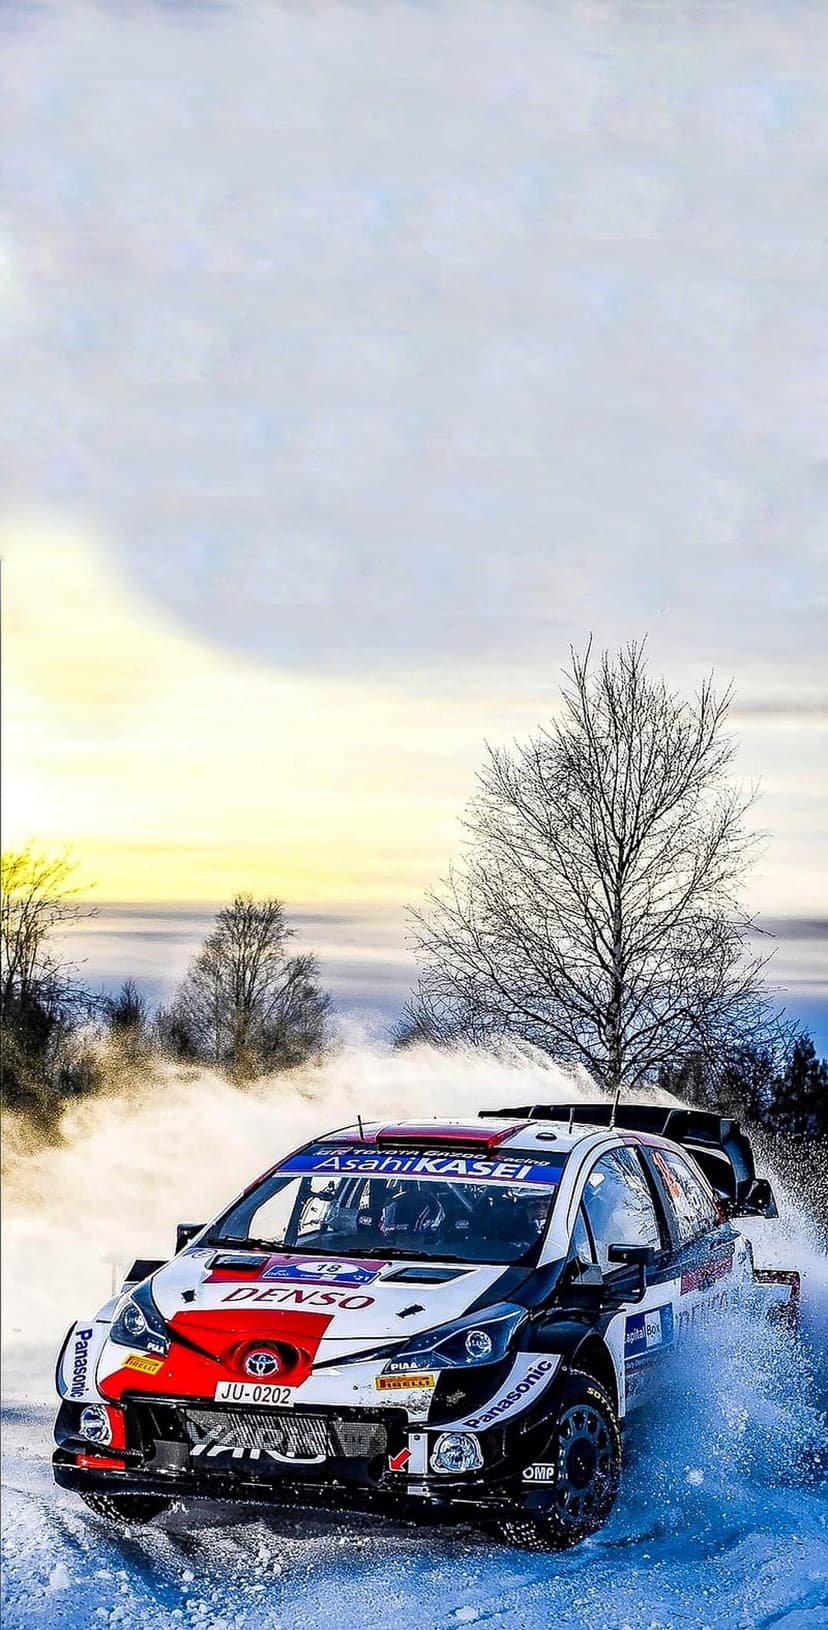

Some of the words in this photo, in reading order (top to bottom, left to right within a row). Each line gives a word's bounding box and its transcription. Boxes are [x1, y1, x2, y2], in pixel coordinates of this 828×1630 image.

[316, 1264, 342, 1272] 18
[222, 1287, 376, 1310] DENSO
[71, 1328, 93, 1398] Panasonic
[125, 1356, 160, 1372] PIRELLI
[390, 1362, 418, 1371] PIAA
[379, 1375, 431, 1389] PIRELLI
[220, 1383, 292, 1405] JU-0202
[462, 1359, 553, 1429] Panasonic
[521, 1464, 555, 1480] OMP
